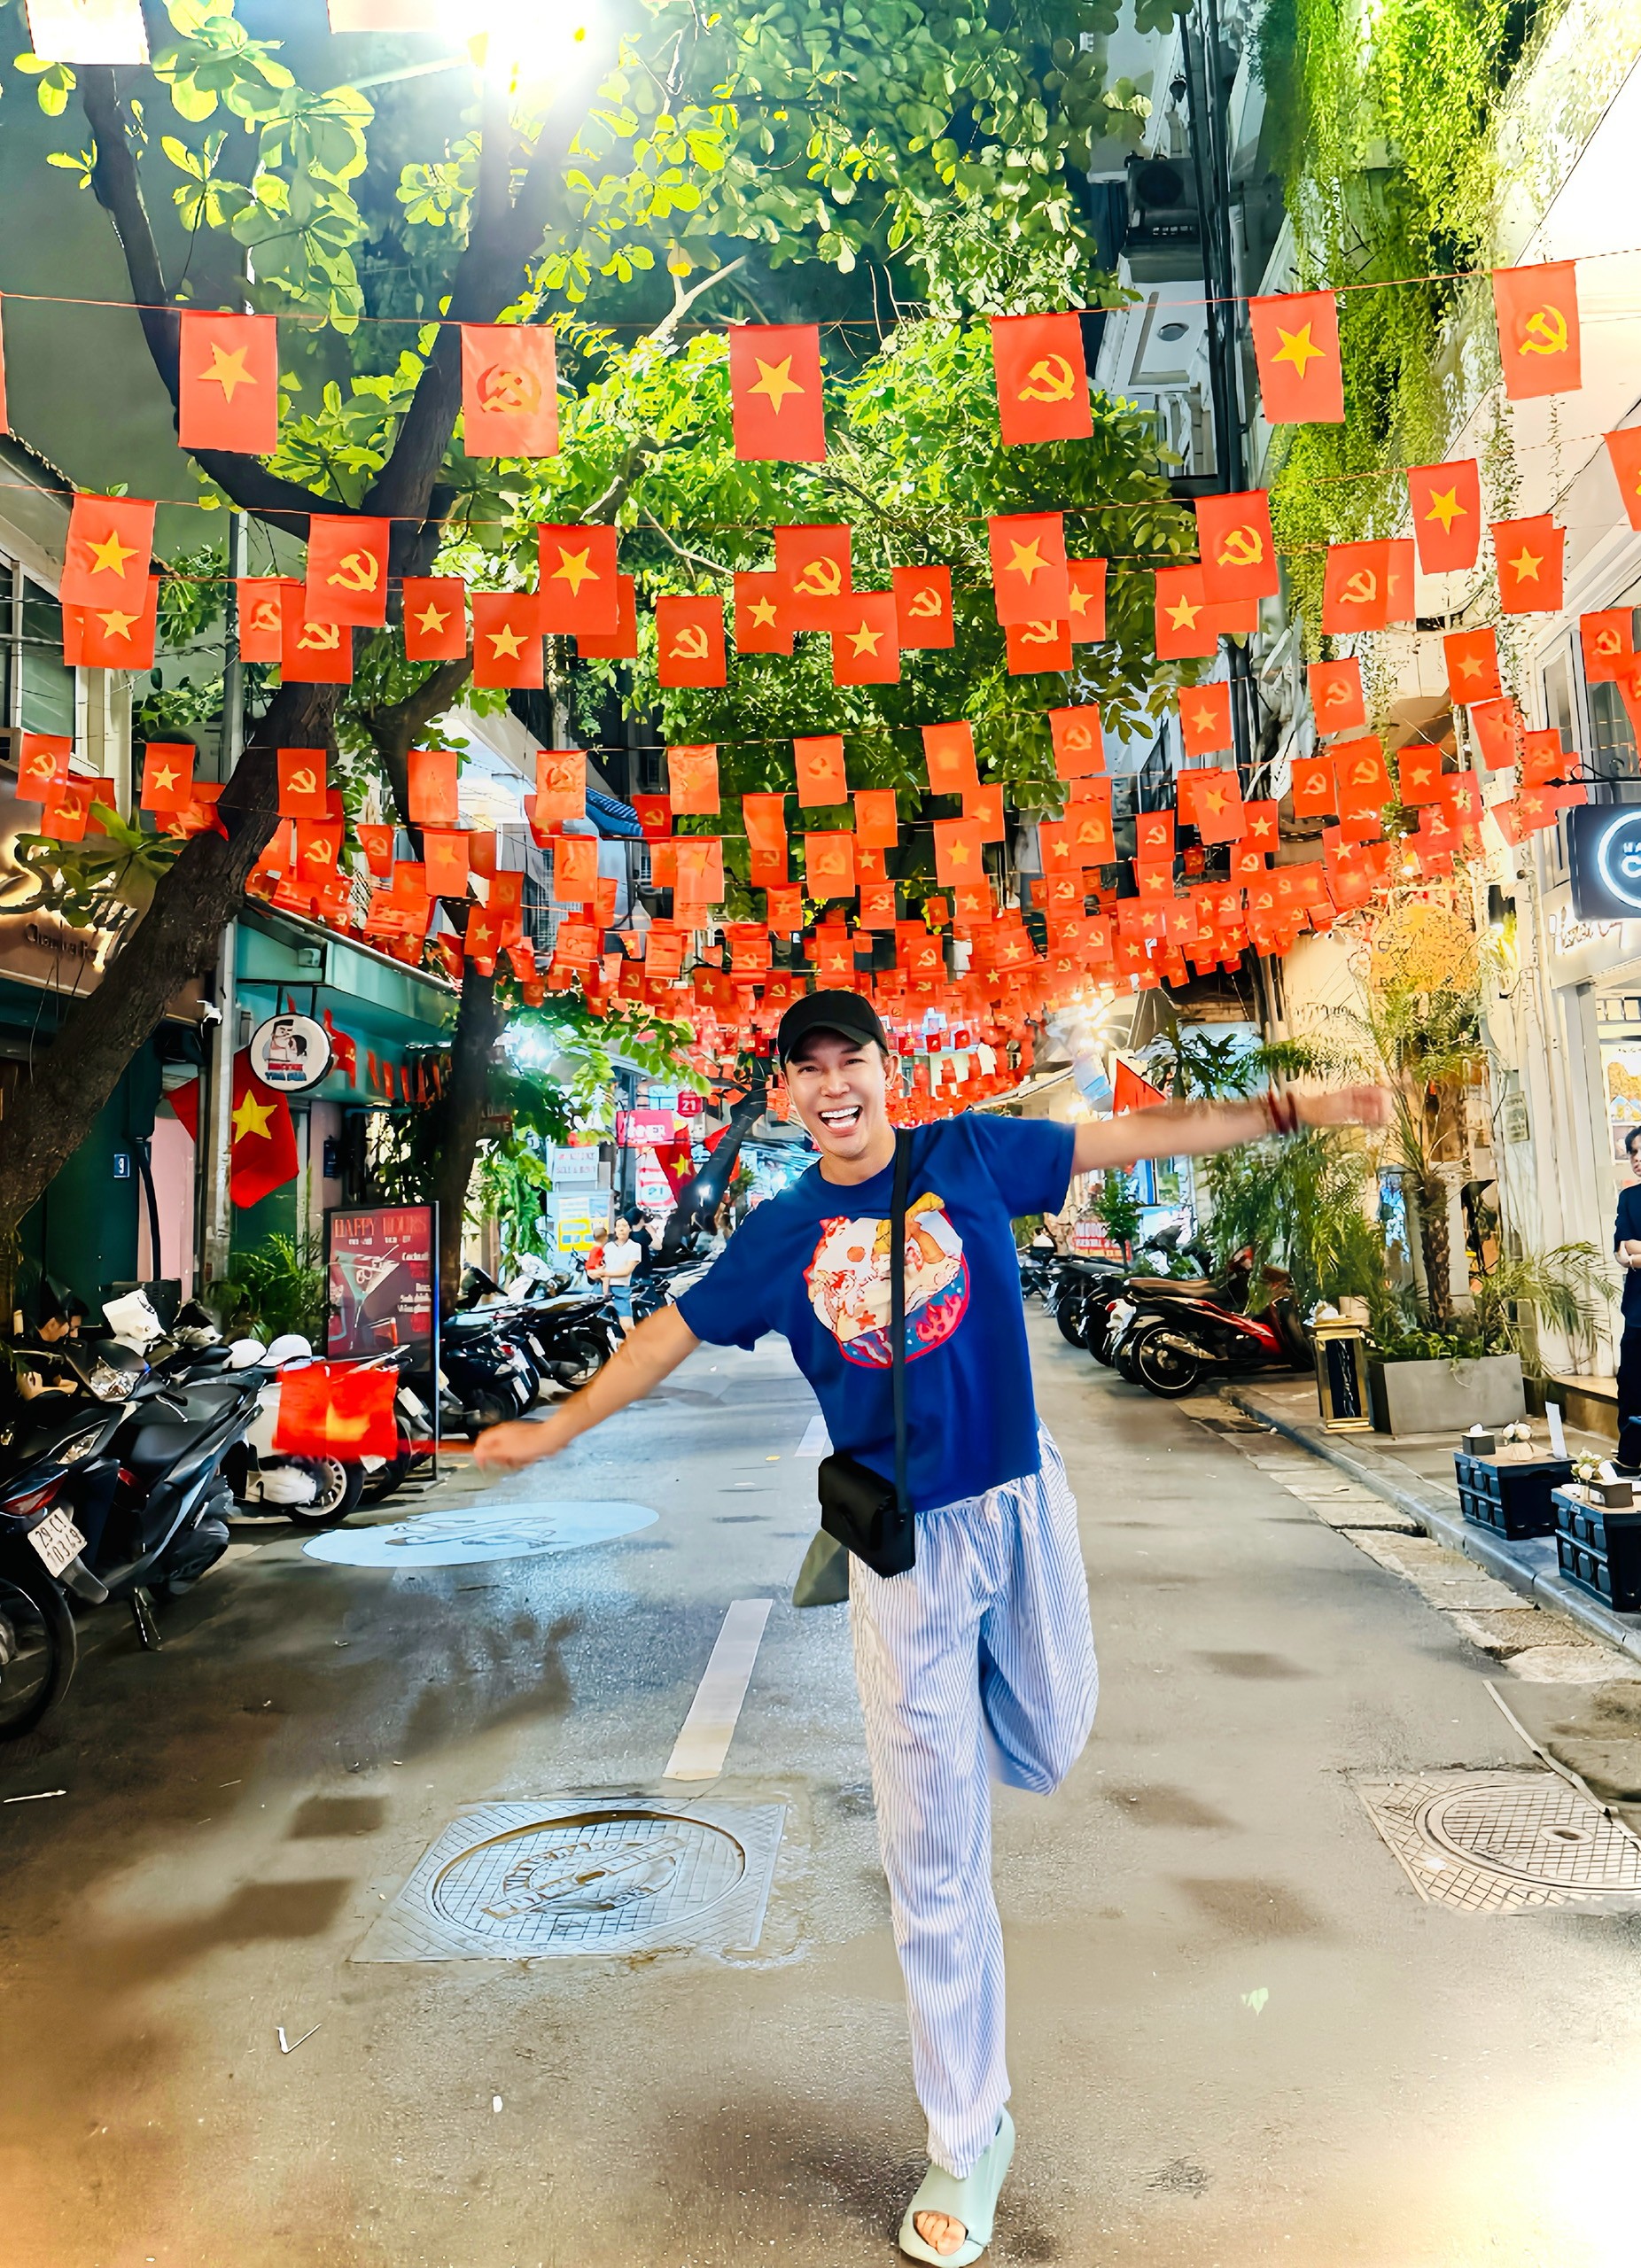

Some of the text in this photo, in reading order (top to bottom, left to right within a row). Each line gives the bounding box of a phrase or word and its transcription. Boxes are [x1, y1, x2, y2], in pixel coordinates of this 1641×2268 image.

[681, 1099, 696, 1111] 21
[334, 1215, 427, 1238] HAPPY HOURS
